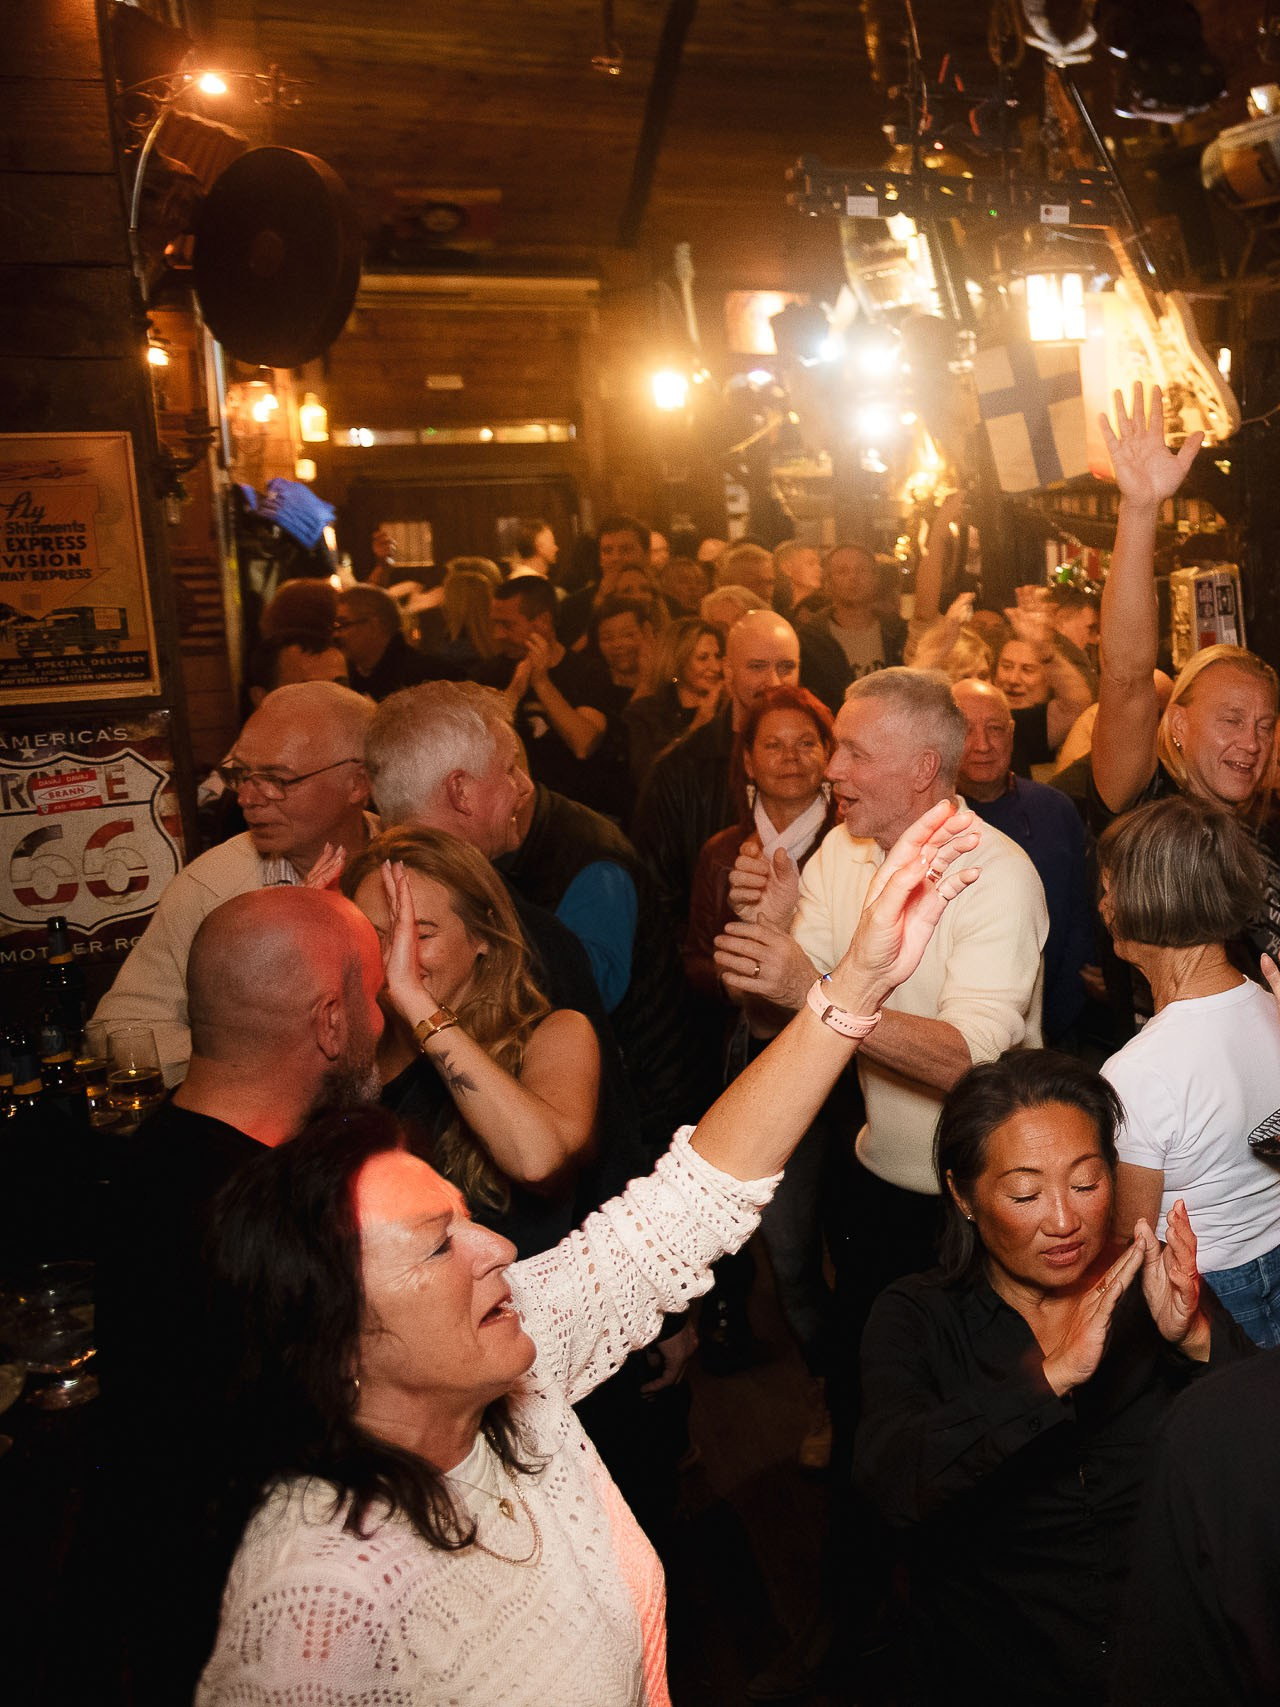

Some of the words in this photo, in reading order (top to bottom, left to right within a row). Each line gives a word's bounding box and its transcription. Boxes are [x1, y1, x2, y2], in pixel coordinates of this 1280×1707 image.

[4, 490, 47, 523] Fly
[5, 519, 86, 537] Shipments
[5, 535, 87, 552] EXPRESS
[2, 553, 81, 568] VISION
[31, 568, 92, 581] EXPRESS
[34, 658, 87, 670] SPECIAL
[91, 655, 145, 667] DELIVERY
[48, 786, 85, 800] BRANN
[10, 817, 150, 913] 66
[1, 940, 104, 964] MOTER
